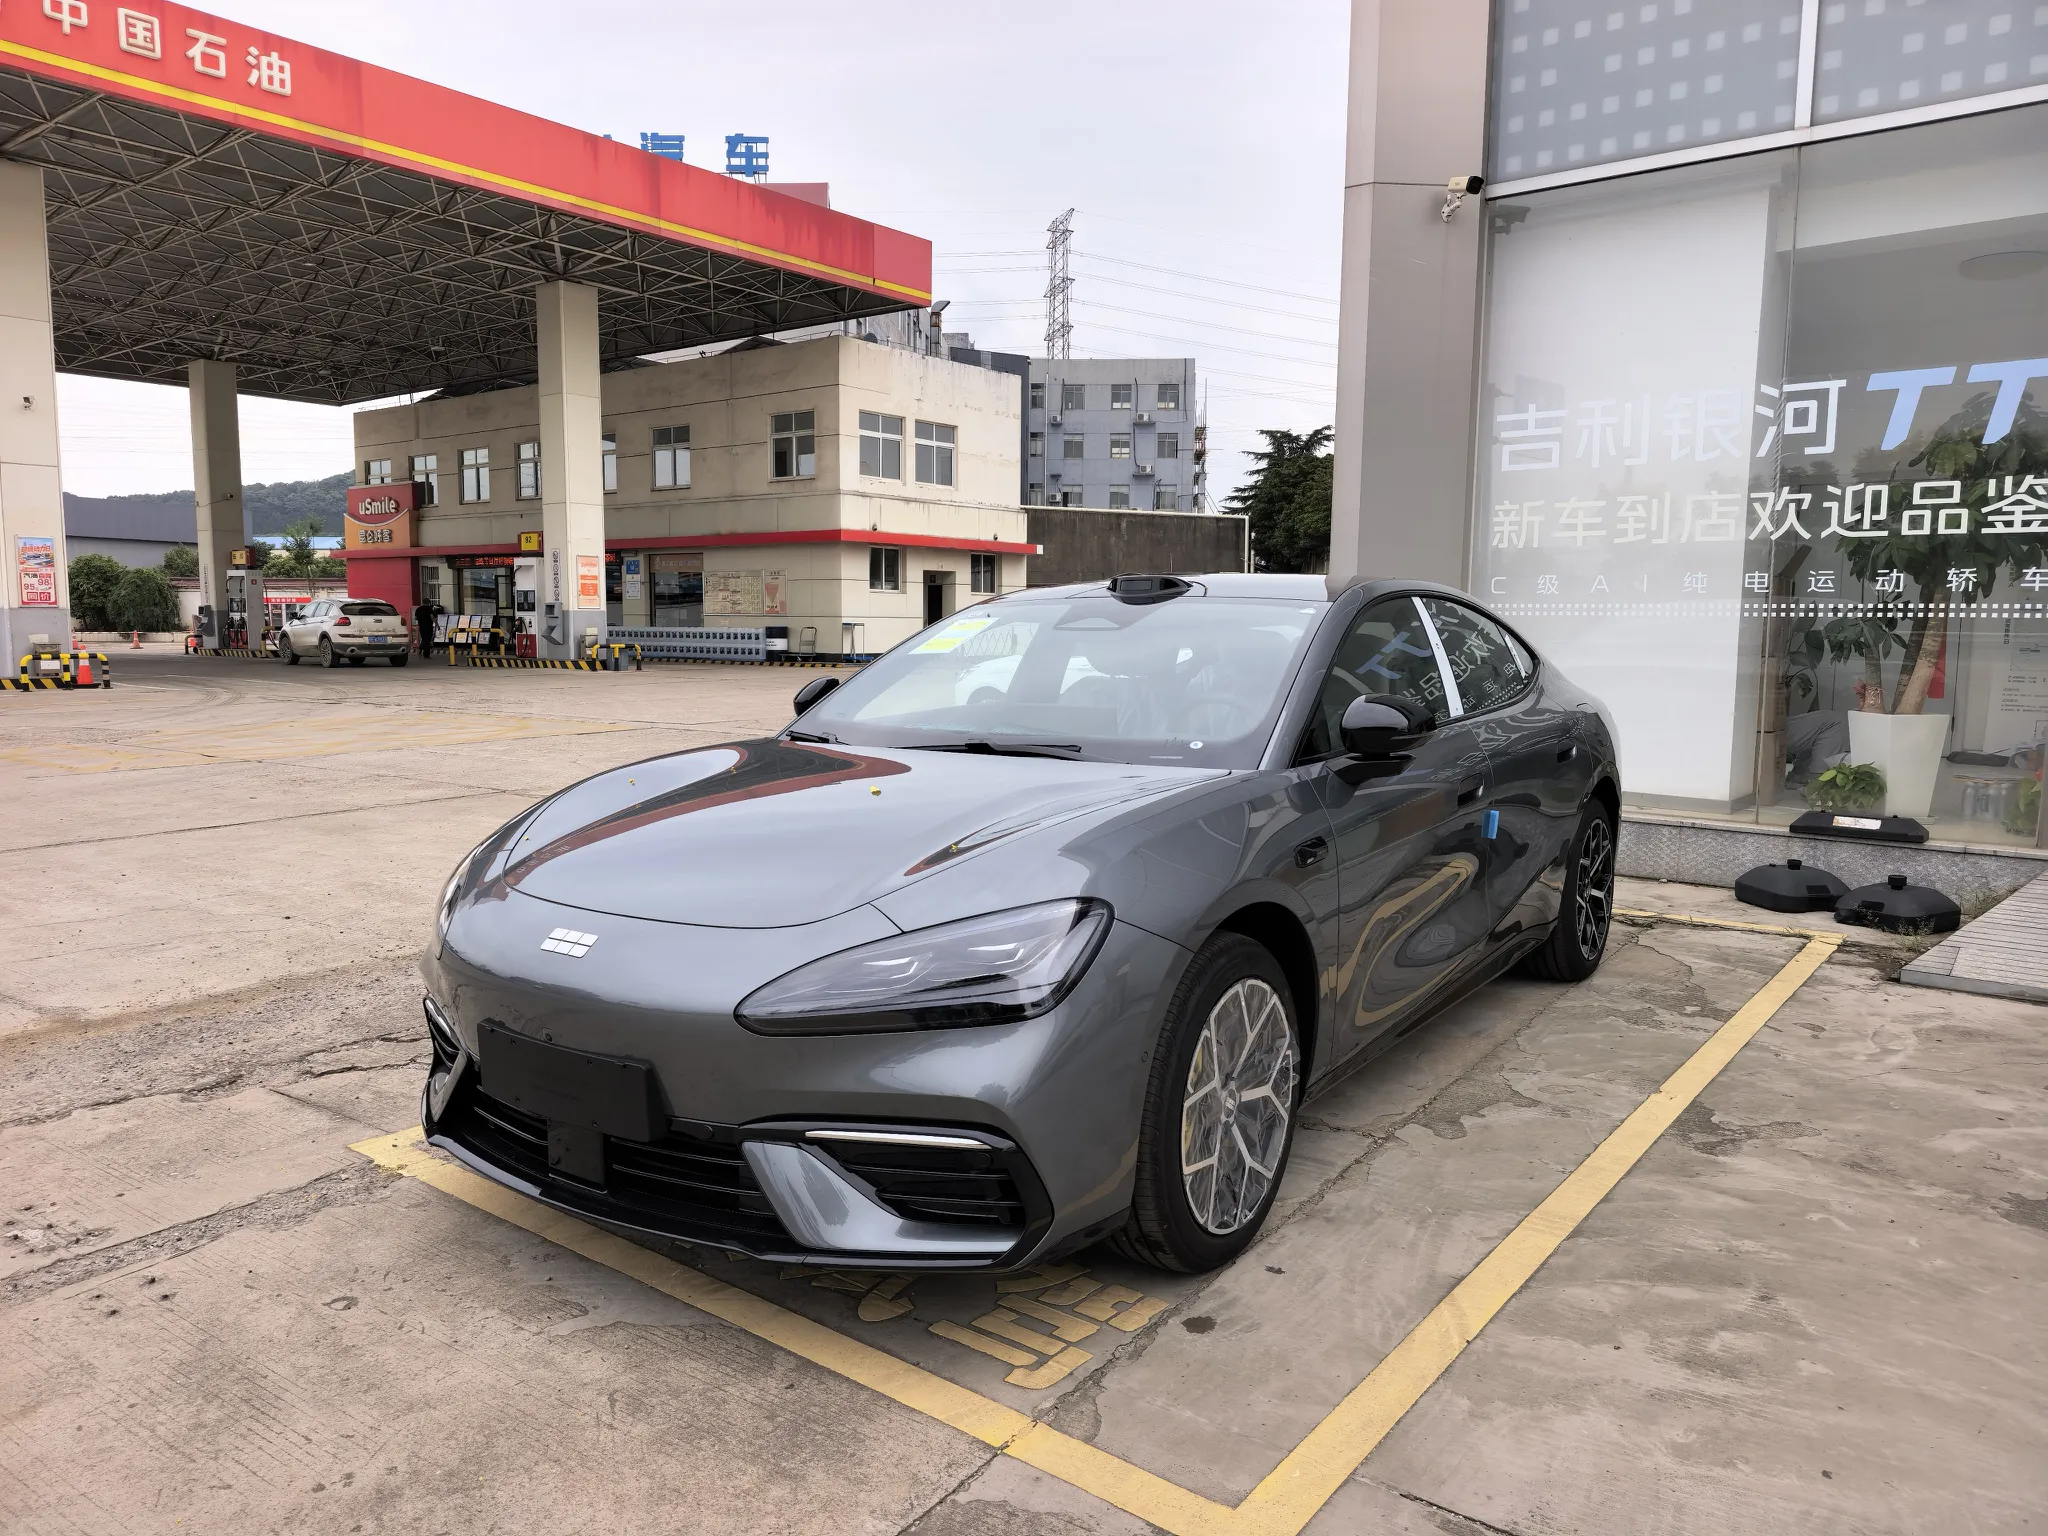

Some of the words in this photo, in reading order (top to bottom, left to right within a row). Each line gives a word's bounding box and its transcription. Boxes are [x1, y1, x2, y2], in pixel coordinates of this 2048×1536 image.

[43, 0, 292, 96] 中国石油
[358, 496, 396, 515] uSmile
[1491, 474, 2048, 549] 新车到店欢迎品鉴
[359, 529, 390, 543] 昆仑好客
